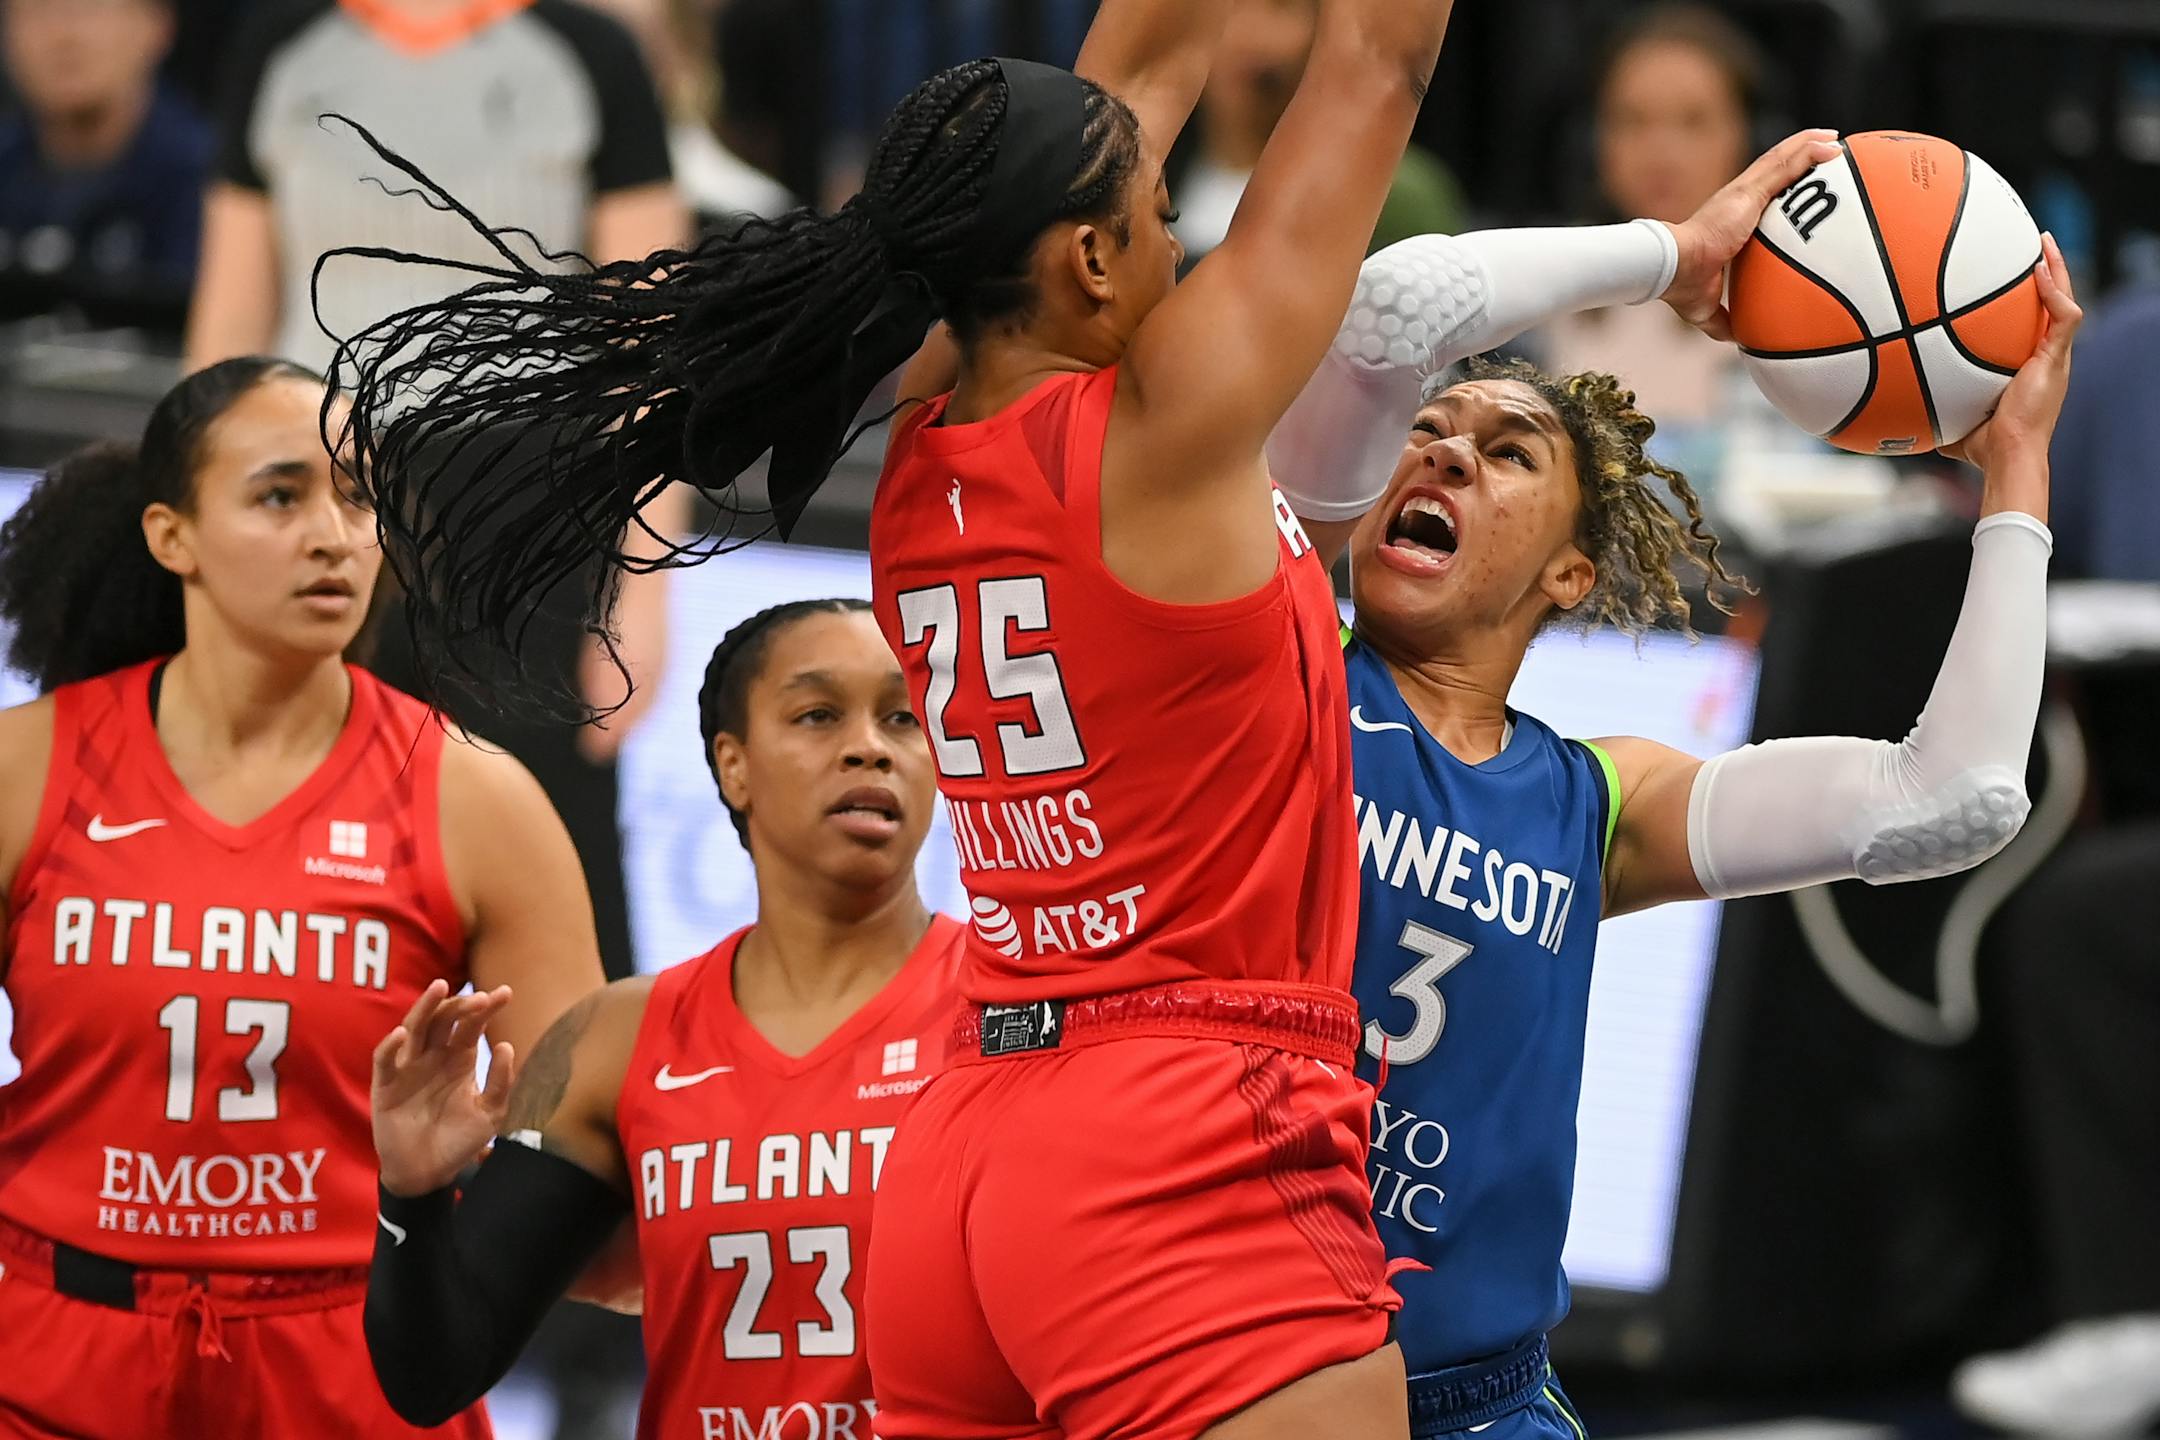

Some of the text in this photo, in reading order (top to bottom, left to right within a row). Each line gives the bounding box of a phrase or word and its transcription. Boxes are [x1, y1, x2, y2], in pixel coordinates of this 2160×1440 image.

[898, 574, 1086, 778] 25
[304, 855, 386, 886] Microsoft
[54, 897, 390, 990] ATLANTA
[1034, 884, 1145, 954] AT&T
[1364, 918, 1475, 1066] 3
[159, 995, 291, 1122] 13
[99, 1145, 327, 1208] EMORY
[641, 1126, 897, 1221] ATLANT
[1369, 1099, 1450, 1169] YO
[98, 1205, 318, 1237] HEALTHCARE
[708, 1225, 856, 1360] 23
